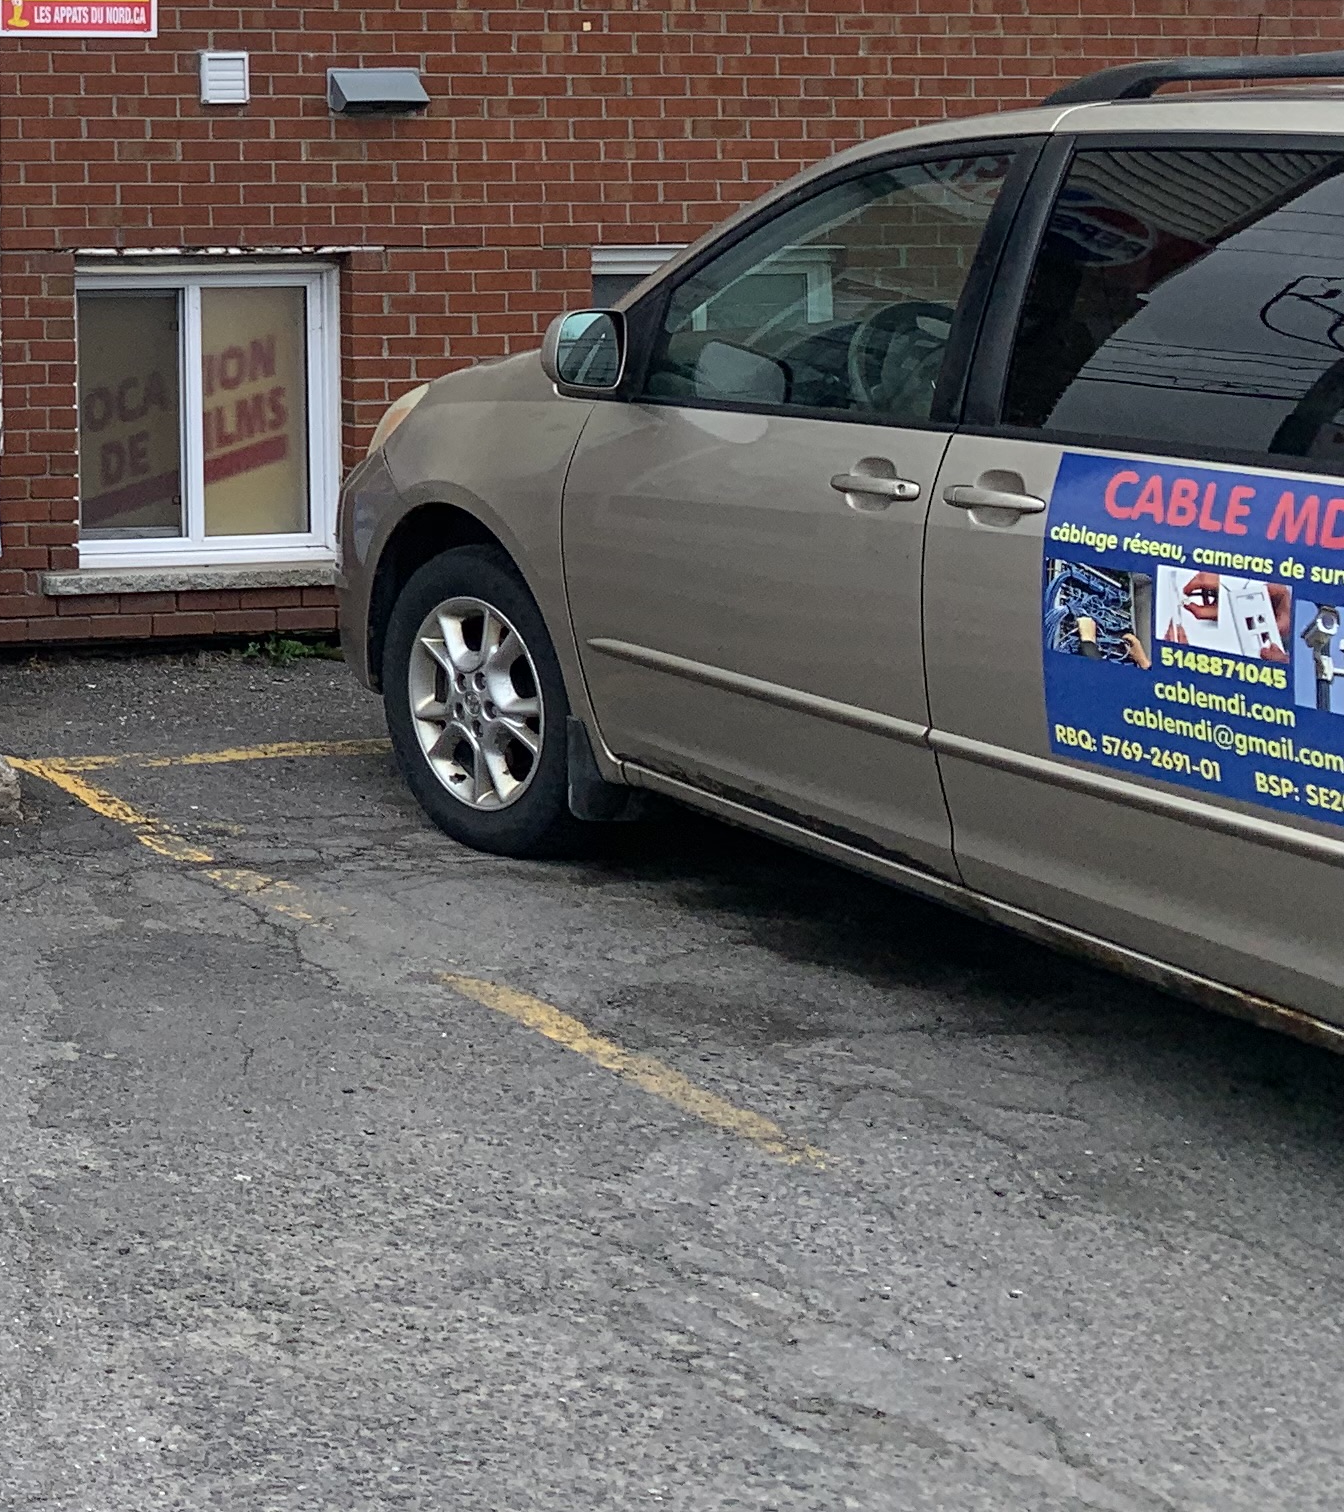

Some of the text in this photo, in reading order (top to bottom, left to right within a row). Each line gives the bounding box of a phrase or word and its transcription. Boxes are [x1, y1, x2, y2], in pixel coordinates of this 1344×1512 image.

[34, 6, 51, 24] LES
[91, 7, 104, 23] DU
[106, 7, 146, 25] NORD.CA
[1104, 470, 1256, 536] CABLE
[1050, 522, 1118, 553] câblage
[1123, 533, 1186, 564] réseau,
[1193, 547, 1274, 574] cameras
[1279, 556, 1305, 579] de
[1161, 647, 1288, 690] 5148871045
[1154, 681, 1296, 728] cablemdi.com
[1055, 723, 1222, 782] RBQ: 5769-2691-01
[1123, 706, 1344, 774] cablemdi@gmail.com
[1255, 771, 1344, 813] BSP: SE2
